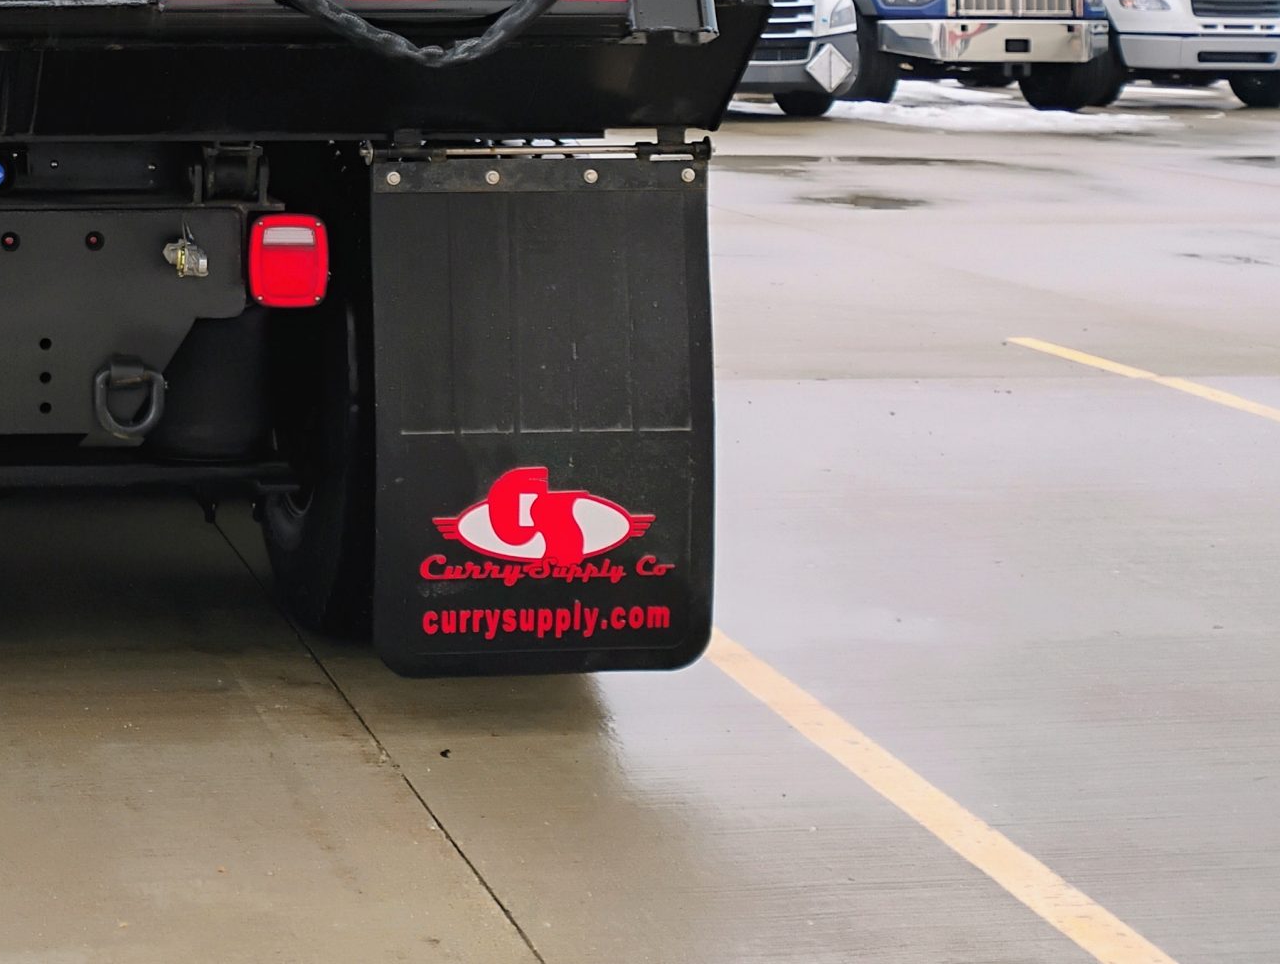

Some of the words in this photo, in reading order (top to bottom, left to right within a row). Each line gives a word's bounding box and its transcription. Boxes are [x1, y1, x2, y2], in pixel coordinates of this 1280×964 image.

[420, 554, 525, 586] Curry
[523, 556, 627, 583] Supply
[635, 554, 676, 576] Co
[422, 599, 671, 640] currysupply.com
